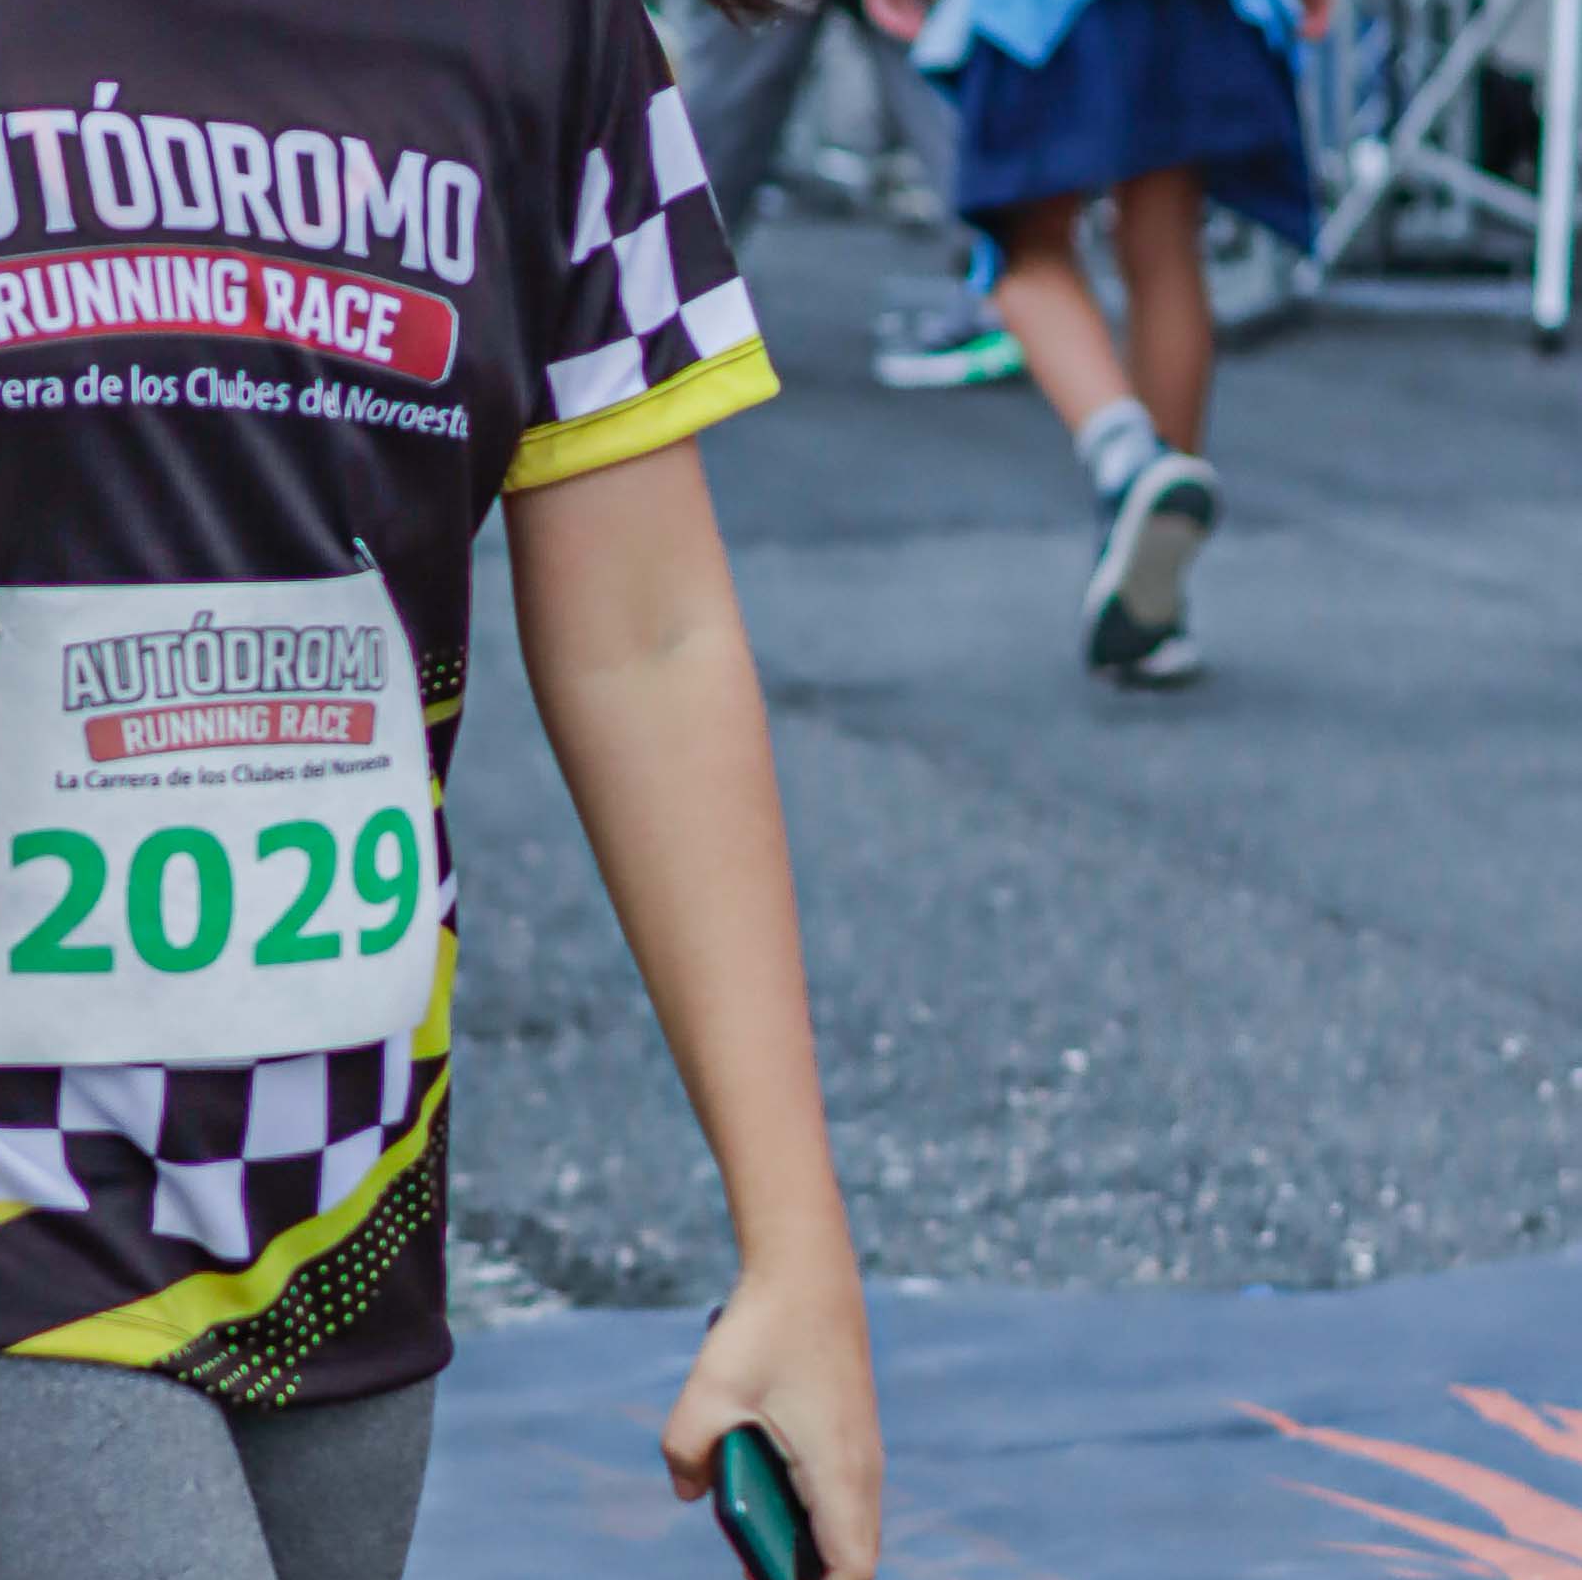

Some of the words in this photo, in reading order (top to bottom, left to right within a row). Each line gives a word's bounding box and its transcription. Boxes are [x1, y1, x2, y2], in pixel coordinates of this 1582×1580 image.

[261, 266, 403, 362] RACE
[74, 365, 123, 406] de
[130, 364, 178, 406] los
[185, 367, 290, 415] Clubes
[62, 610, 388, 712] AUTÓDROMO
[120, 702, 270, 755] RUNNING
[279, 702, 354, 742] RACE
[56, 771, 79, 790] La
[84, 769, 161, 789] Carrera
[167, 767, 192, 787] de
[198, 765, 227, 786] los
[232, 763, 295, 785] Clubes
[9, 805, 419, 974] 2029
